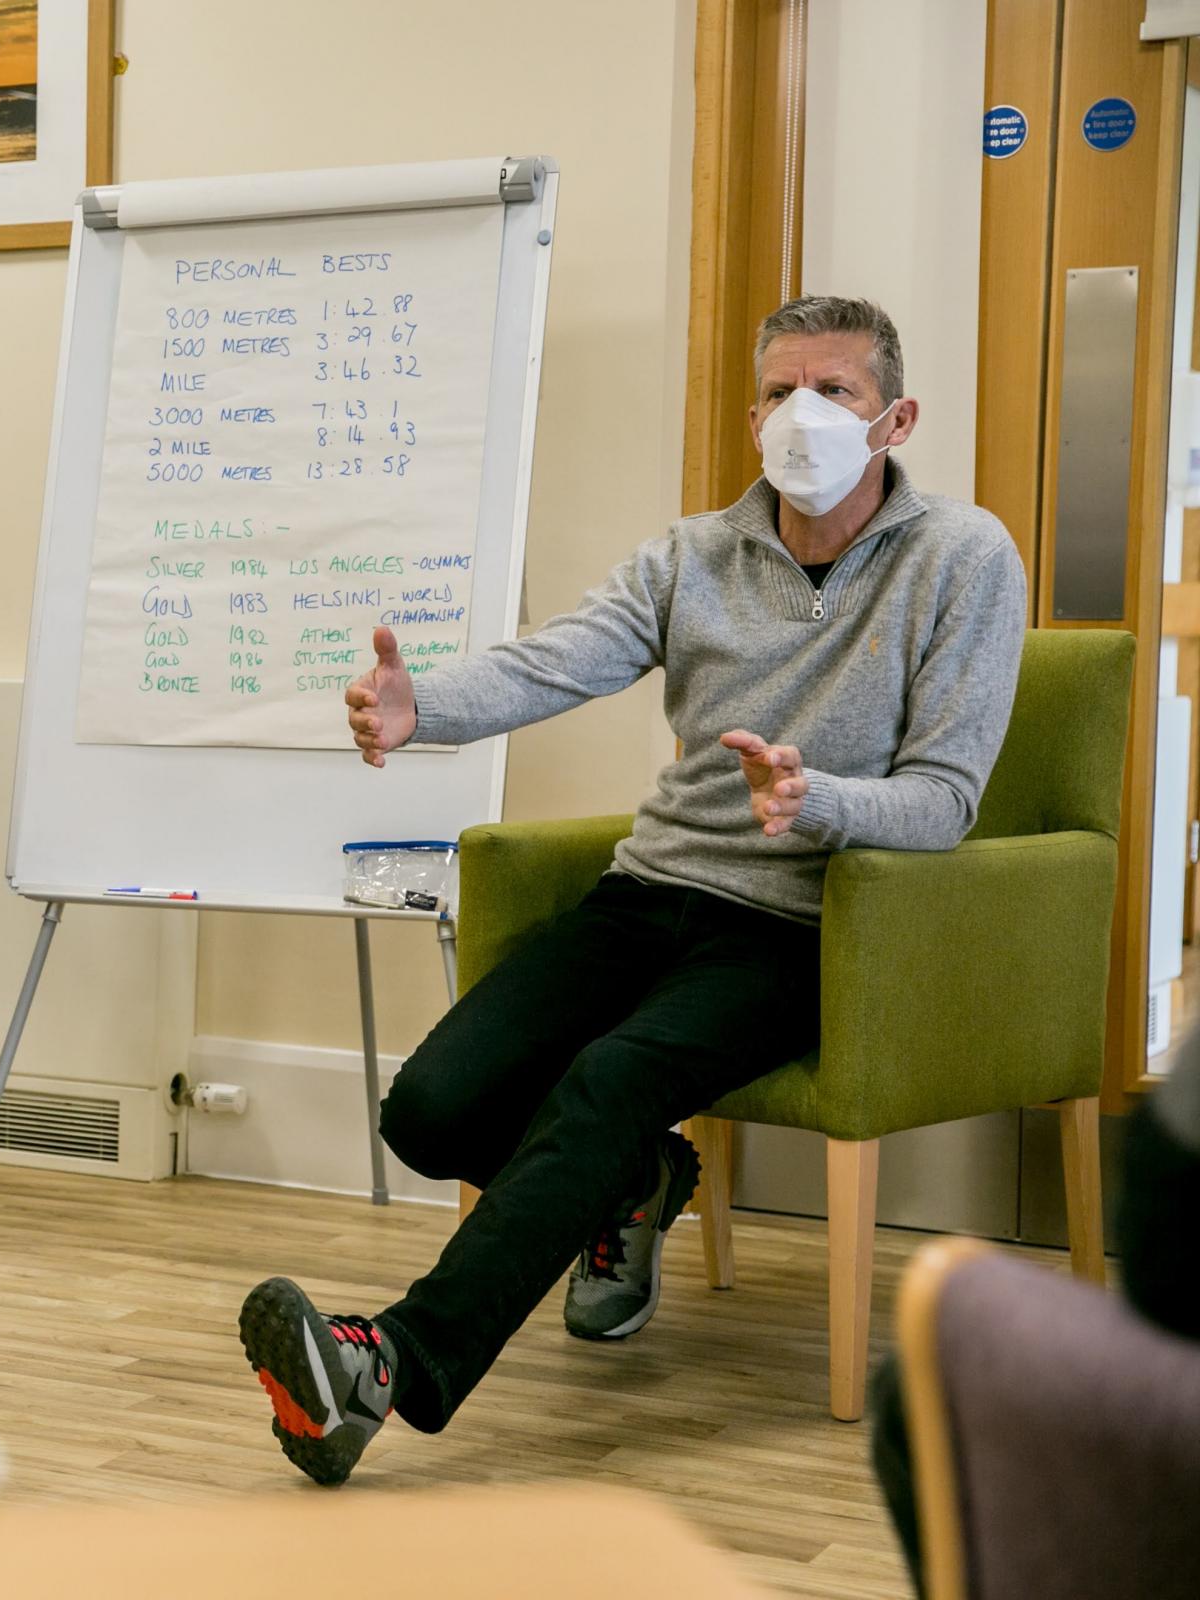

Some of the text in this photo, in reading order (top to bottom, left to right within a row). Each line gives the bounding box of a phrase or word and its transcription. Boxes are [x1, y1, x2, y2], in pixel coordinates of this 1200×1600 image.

[999, 126, 1018, 136] door
[1001, 136, 1021, 146] clear
[175, 253, 392, 284] PERSONAL BESTS
[166, 307, 210, 330] 800
[223, 307, 297, 327] METRES
[163, 337, 206, 359] 1500
[222, 336, 290, 357] METRES
[160, 372, 207, 393] MILE
[148, 407, 203, 426] 3000
[220, 407, 276, 424] METRES
[148, 437, 162, 456] 2
[171, 440, 212, 456] MILE
[146, 463, 204, 482] 5000
[221, 466, 273, 481] METRES
[145, 556, 205, 579] SILVER
[231, 559, 268, 579] 1984
[289, 559, 319, 576] LOS
[329, 555, 404, 575] ANGELES
[142, 585, 193, 619] GOLD
[229, 592, 268, 615] 1983
[293, 588, 381, 610] HELSINKI
[402, 583, 453, 603] WORLD
[144, 621, 352, 647] GOLD 1982 ATHENS
[400, 639, 460, 656] EUROPEAN
[229, 651, 264, 669] 1986
[293, 649, 364, 667] STUTTGART
[138, 671, 200, 693] BRONZE
[231, 675, 262, 694] 1986
